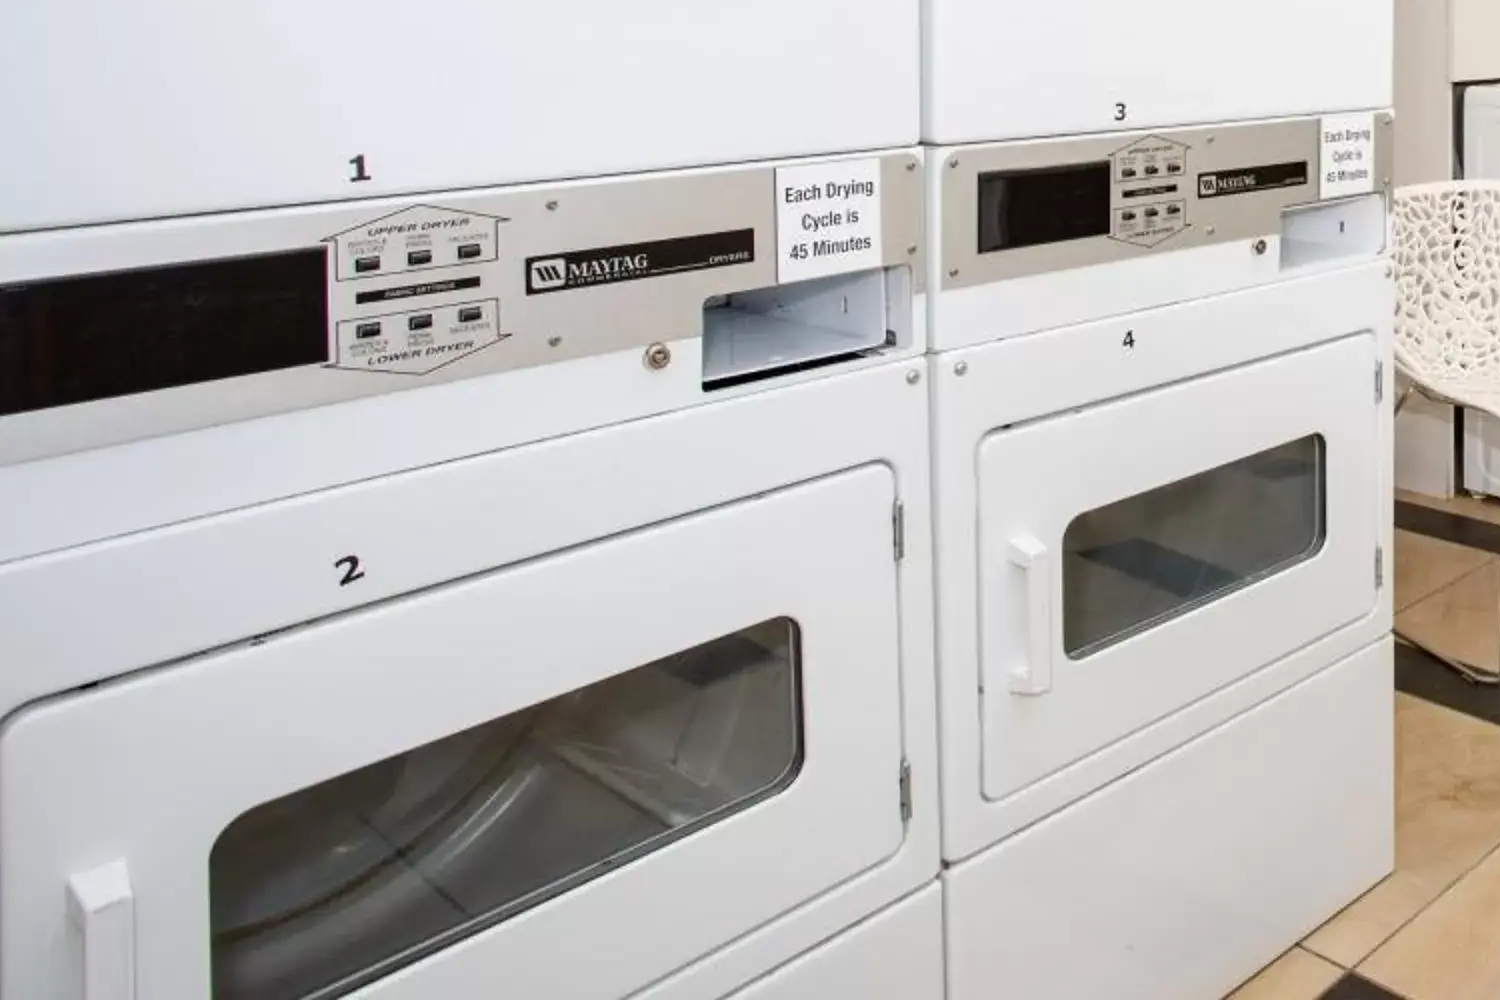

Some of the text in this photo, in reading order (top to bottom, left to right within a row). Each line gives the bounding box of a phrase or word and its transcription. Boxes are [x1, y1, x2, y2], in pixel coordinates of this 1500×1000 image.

[1114, 102, 1128, 122] 3
[349, 154, 372, 183] 1
[784, 179, 874, 204] Each Drying
[367, 217, 471, 238] UPPER DRYER
[801, 209, 860, 232] Cycle is
[789, 237, 872, 260] 45 Minutes
[568, 253, 649, 279] MAYTAG
[1122, 330, 1136, 349] 4
[367, 349, 421, 366] LOWER
[424, 340, 475, 356] DRYER
[334, 555, 365, 587] 2
